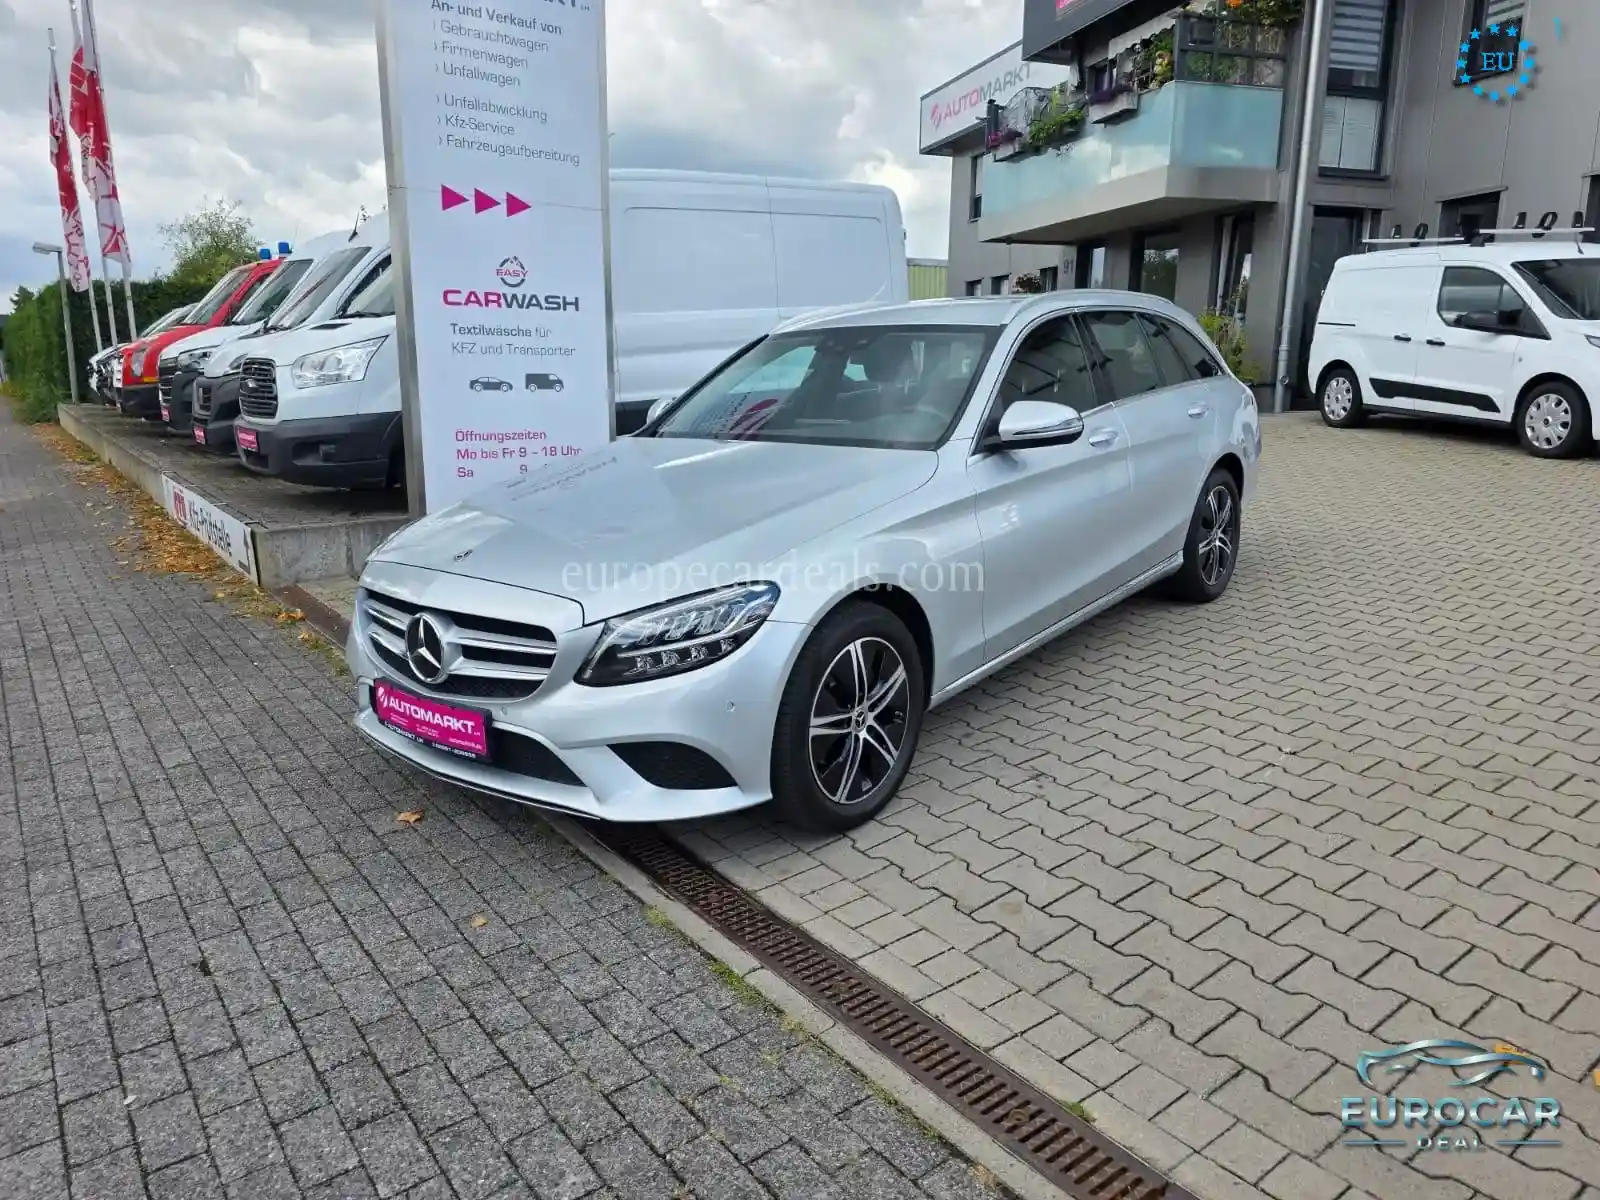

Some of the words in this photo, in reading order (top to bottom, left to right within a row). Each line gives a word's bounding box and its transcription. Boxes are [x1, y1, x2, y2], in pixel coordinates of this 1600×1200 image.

[431, 0, 454, 12] An-
[458, 3, 482, 18] und
[487, 9, 538, 30] Verkauf
[540, 22, 562, 35] von
[440, 20, 549, 52] Gebrauchtwagen
[442, 40, 528, 69] Firmenwagen
[443, 61, 521, 88] Unfallwagen
[943, 62, 1030, 119] AUTOMARKT
[444, 92, 548, 124] Unfallabwicklung
[445, 113, 515, 136] Kfz-Service
[446, 134, 580, 167] Fahrzeugaufbereitung
[496, 267, 528, 278] EASY
[1063, 259, 1073, 274] 91
[443, 289, 580, 312] CARWASH
[450, 322, 532, 338] Textilwäsche
[534, 326, 552, 338] für
[451, 342, 477, 355] KFZ
[480, 343, 503, 355] und
[508, 343, 577, 361] Transporter
[455, 427, 547, 443] Öffnungszeiten
[456, 448, 477, 460] Mo
[480, 448, 498, 460] bis
[502, 447, 515, 459] Fr
[518, 446, 527, 458] 9
[541, 446, 557, 457] 18
[560, 445, 584, 457] Uhr
[456, 466, 475, 478] Sa
[389, 695, 475, 734] AUTOMARKT
